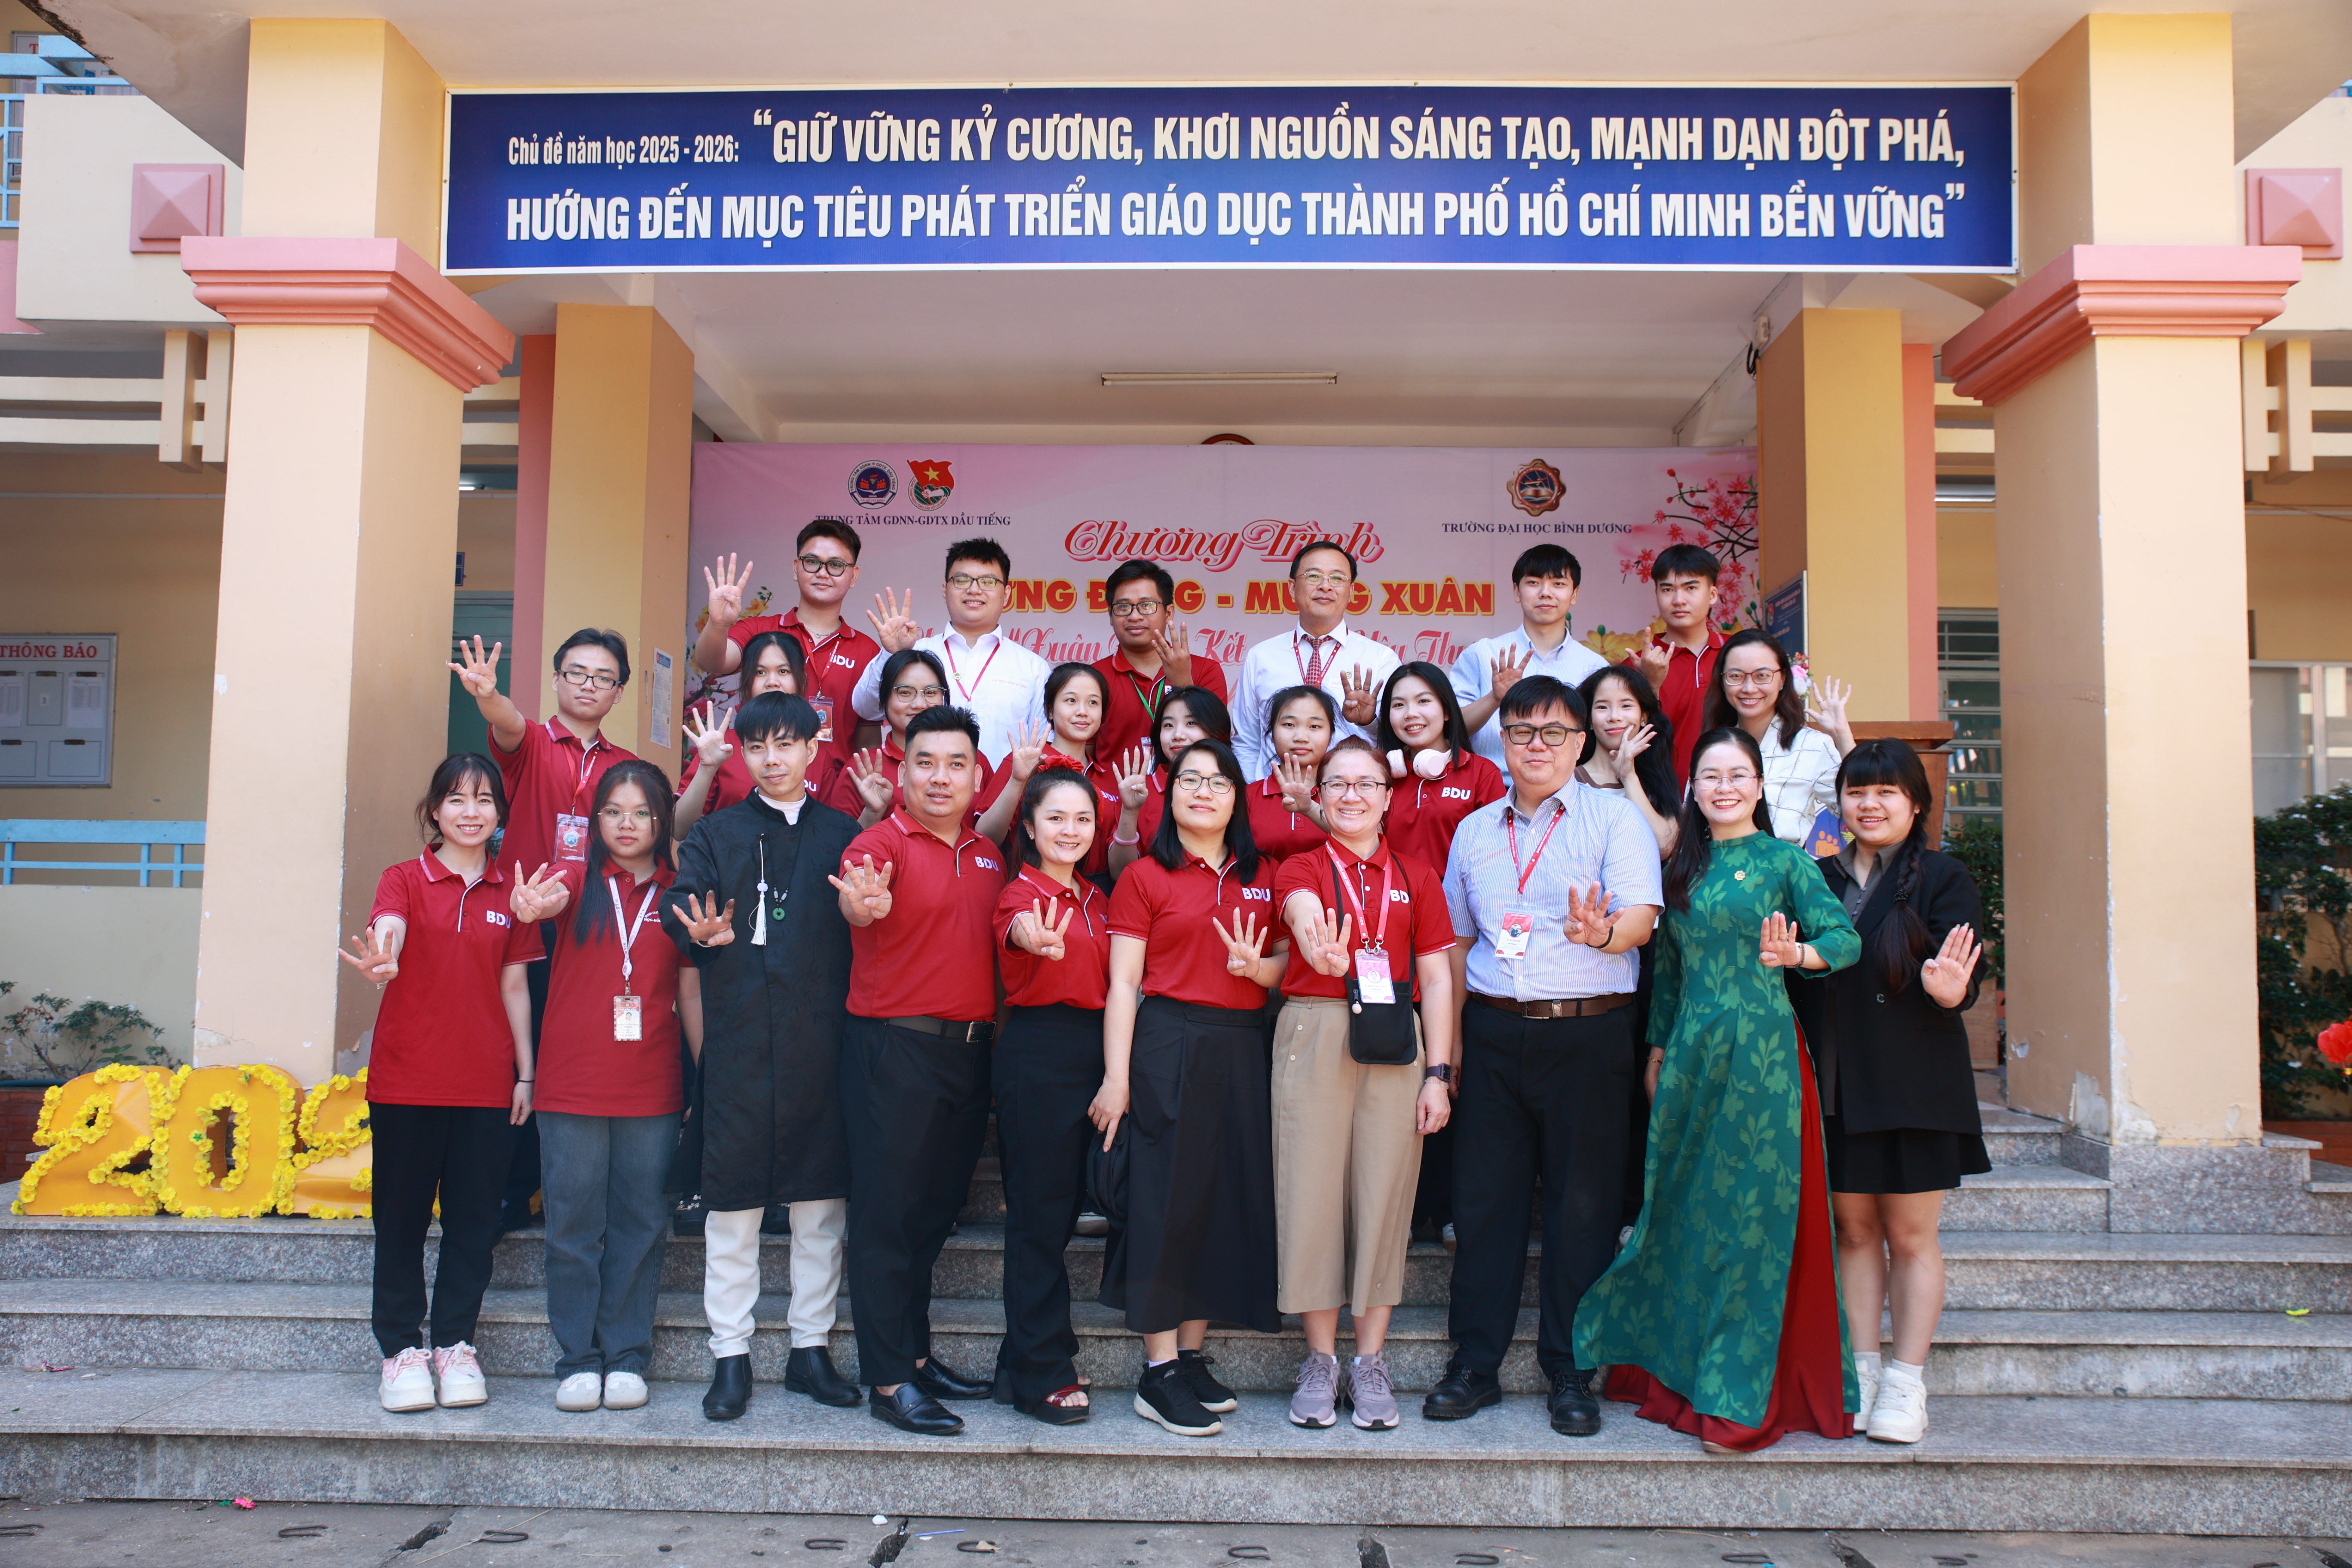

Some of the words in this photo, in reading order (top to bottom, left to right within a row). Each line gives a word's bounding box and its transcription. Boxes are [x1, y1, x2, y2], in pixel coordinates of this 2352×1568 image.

[508, 136, 539, 165] Chủ
[543, 131, 564, 165] đề
[566, 135, 602, 165] năm
[605, 136, 636, 170] học
[639, 135, 680, 164] 2025
[694, 135, 739, 164] 2026:
[842, 110, 940, 162] VỮNG
[950, 103, 998, 161] KỶ
[1007, 112, 1144, 165] CƯƠNG,
[1154, 111, 1240, 160] KHƠI
[1250, 101, 1380, 160] NGUỒN
[1390, 107, 1491, 160] SÁNG
[1501, 116, 1581, 170] TẠO,
[1591, 116, 1703, 170] MẠNH
[1713, 117, 1790, 171] DẠN
[1798, 108, 1870, 171] ĐỘT
[1879, 109, 1965, 167] PHÁ,
[507, 188, 630, 241] HƯỚNG
[638, 182, 712, 239] ĐẾN
[722, 194, 804, 248] MỤC
[813, 185, 891, 238] TIÊU
[901, 184, 996, 237] PHÁT
[1004, 175, 1111, 236] TRIỂN
[1121, 183, 1207, 236] GIÁO
[1217, 191, 1292, 245] DỤC
[1301, 182, 1424, 236] THÀNH
[1434, 177, 1510, 236] PHỐ
[1519, 178, 1568, 236] HỒ
[1579, 183, 1642, 237] CHÍ
[1651, 193, 1750, 237] MINH
[1760, 179, 1835, 237] BỀN
[857, 513, 881, 525] TÂM
[883, 515, 949, 526] GDNN-GDTX
[951, 511, 975, 526] DẦU
[977, 511, 1011, 526] TIẾNG
[1442, 521, 1495, 533] TRƯỜNG
[1498, 523, 1520, 536] ĐẠI
[1523, 523, 1551, 536] HỌC
[1553, 521, 1584, 533] BÌNH
[1587, 523, 1632, 533] DƯƠNG
[1064, 519, 1240, 570] Chương
[1002, 578, 1078, 613] NG
[1084, 578, 1206, 614] ĐG
[1215, 593, 1234, 608] -
[1378, 575, 1495, 616] XUÂN
[0, 642, 57, 658] THÔNG
[63, 642, 98, 658] BÁO
[1441, 787, 1472, 801] BDU
[974, 856, 999, 872] BDU
[1241, 887, 1271, 903] BDU
[1389, 889, 1410, 904] BD
[486, 910, 511, 929] BDU
